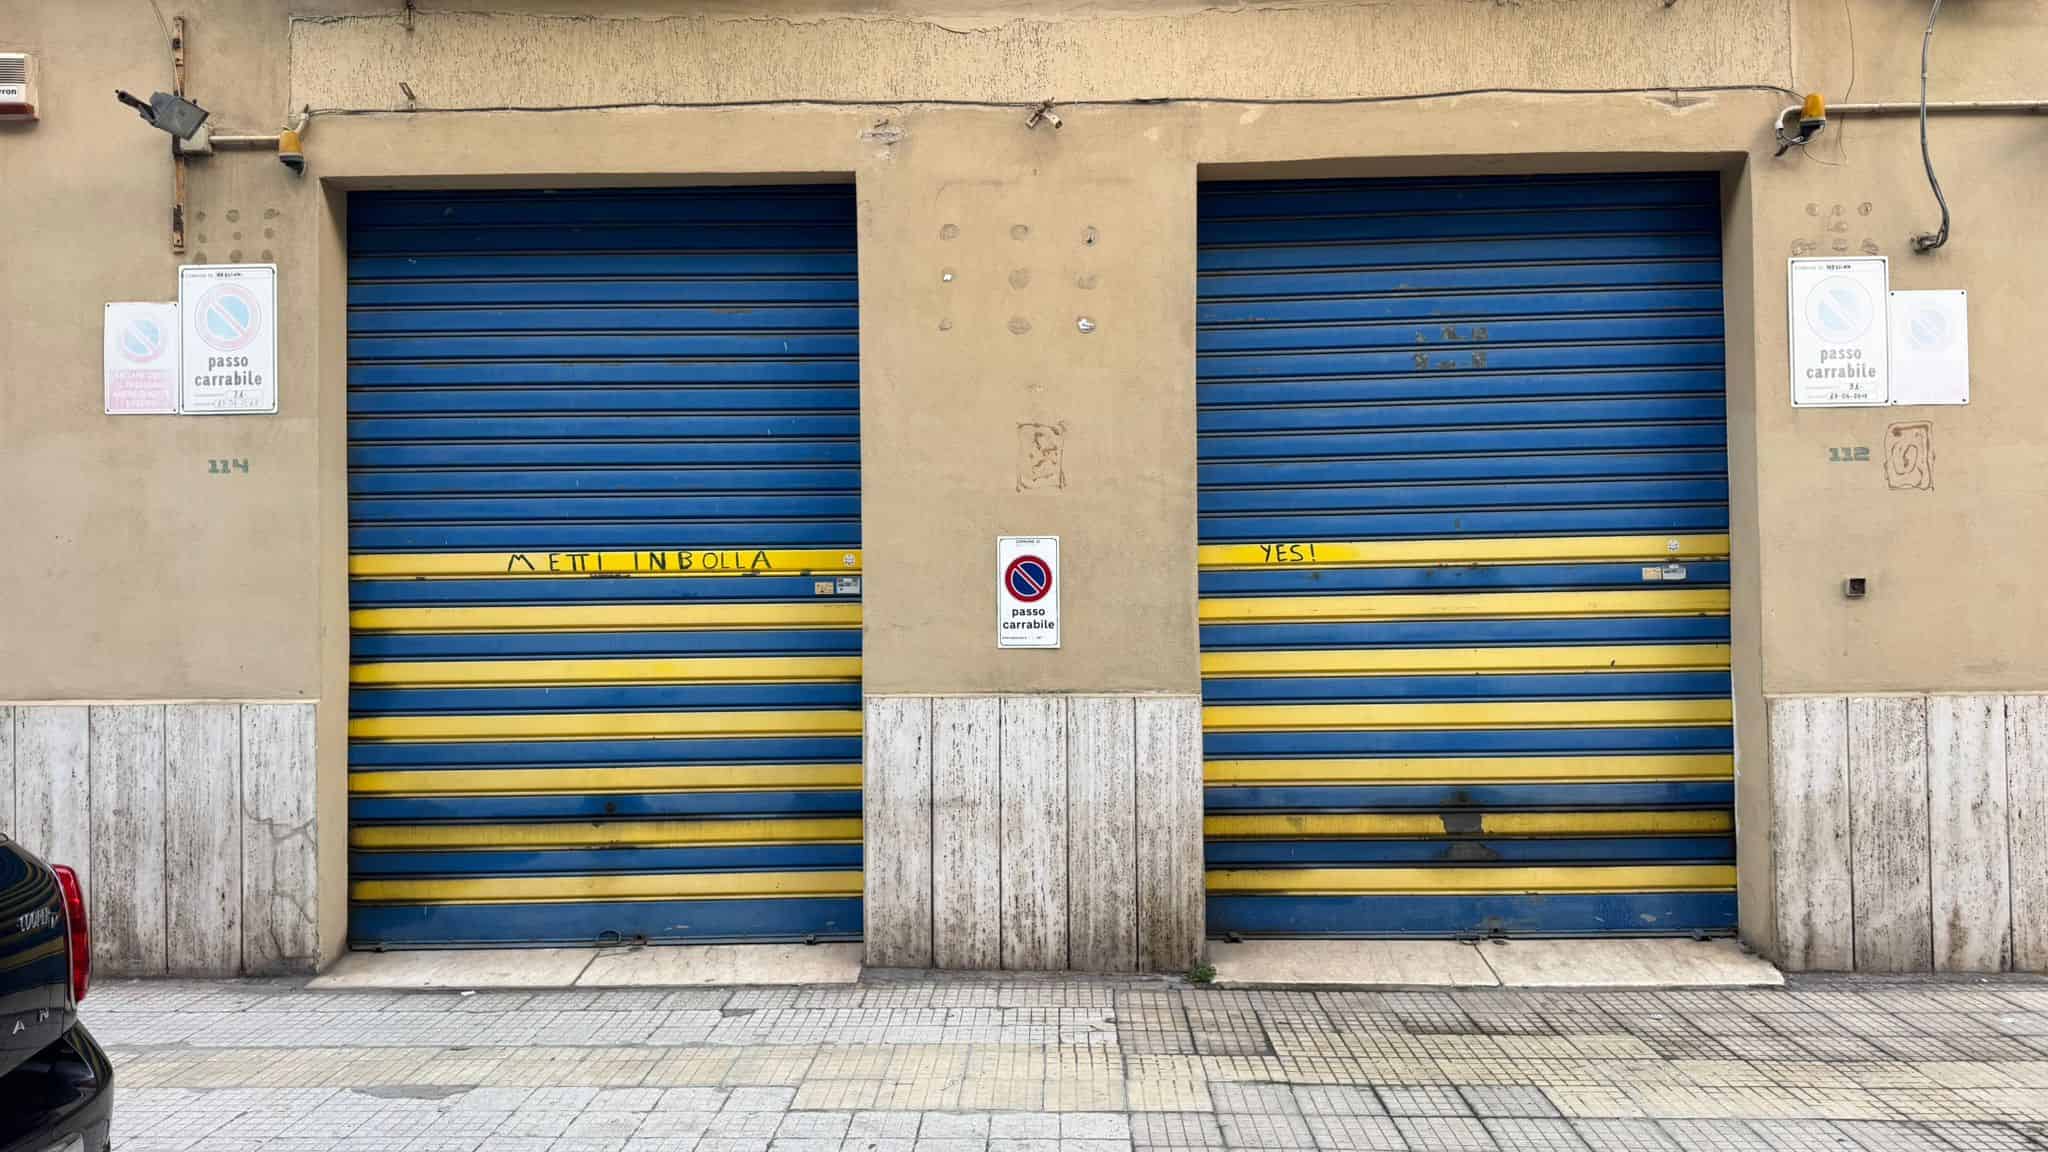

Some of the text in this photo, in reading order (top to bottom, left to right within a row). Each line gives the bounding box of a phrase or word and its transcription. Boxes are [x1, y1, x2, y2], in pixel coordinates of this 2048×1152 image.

[208, 356, 249, 371] passo
[1820, 348, 1862, 364] passo
[195, 369, 262, 386] carrabile
[1806, 363, 1876, 379] carrabile
[1829, 447, 1870, 462] 112
[207, 458, 249, 474] 114
[1260, 543, 1317, 563] YES!
[1011, 608, 1046, 618] passo
[1002, 619, 1055, 630] carrabile
